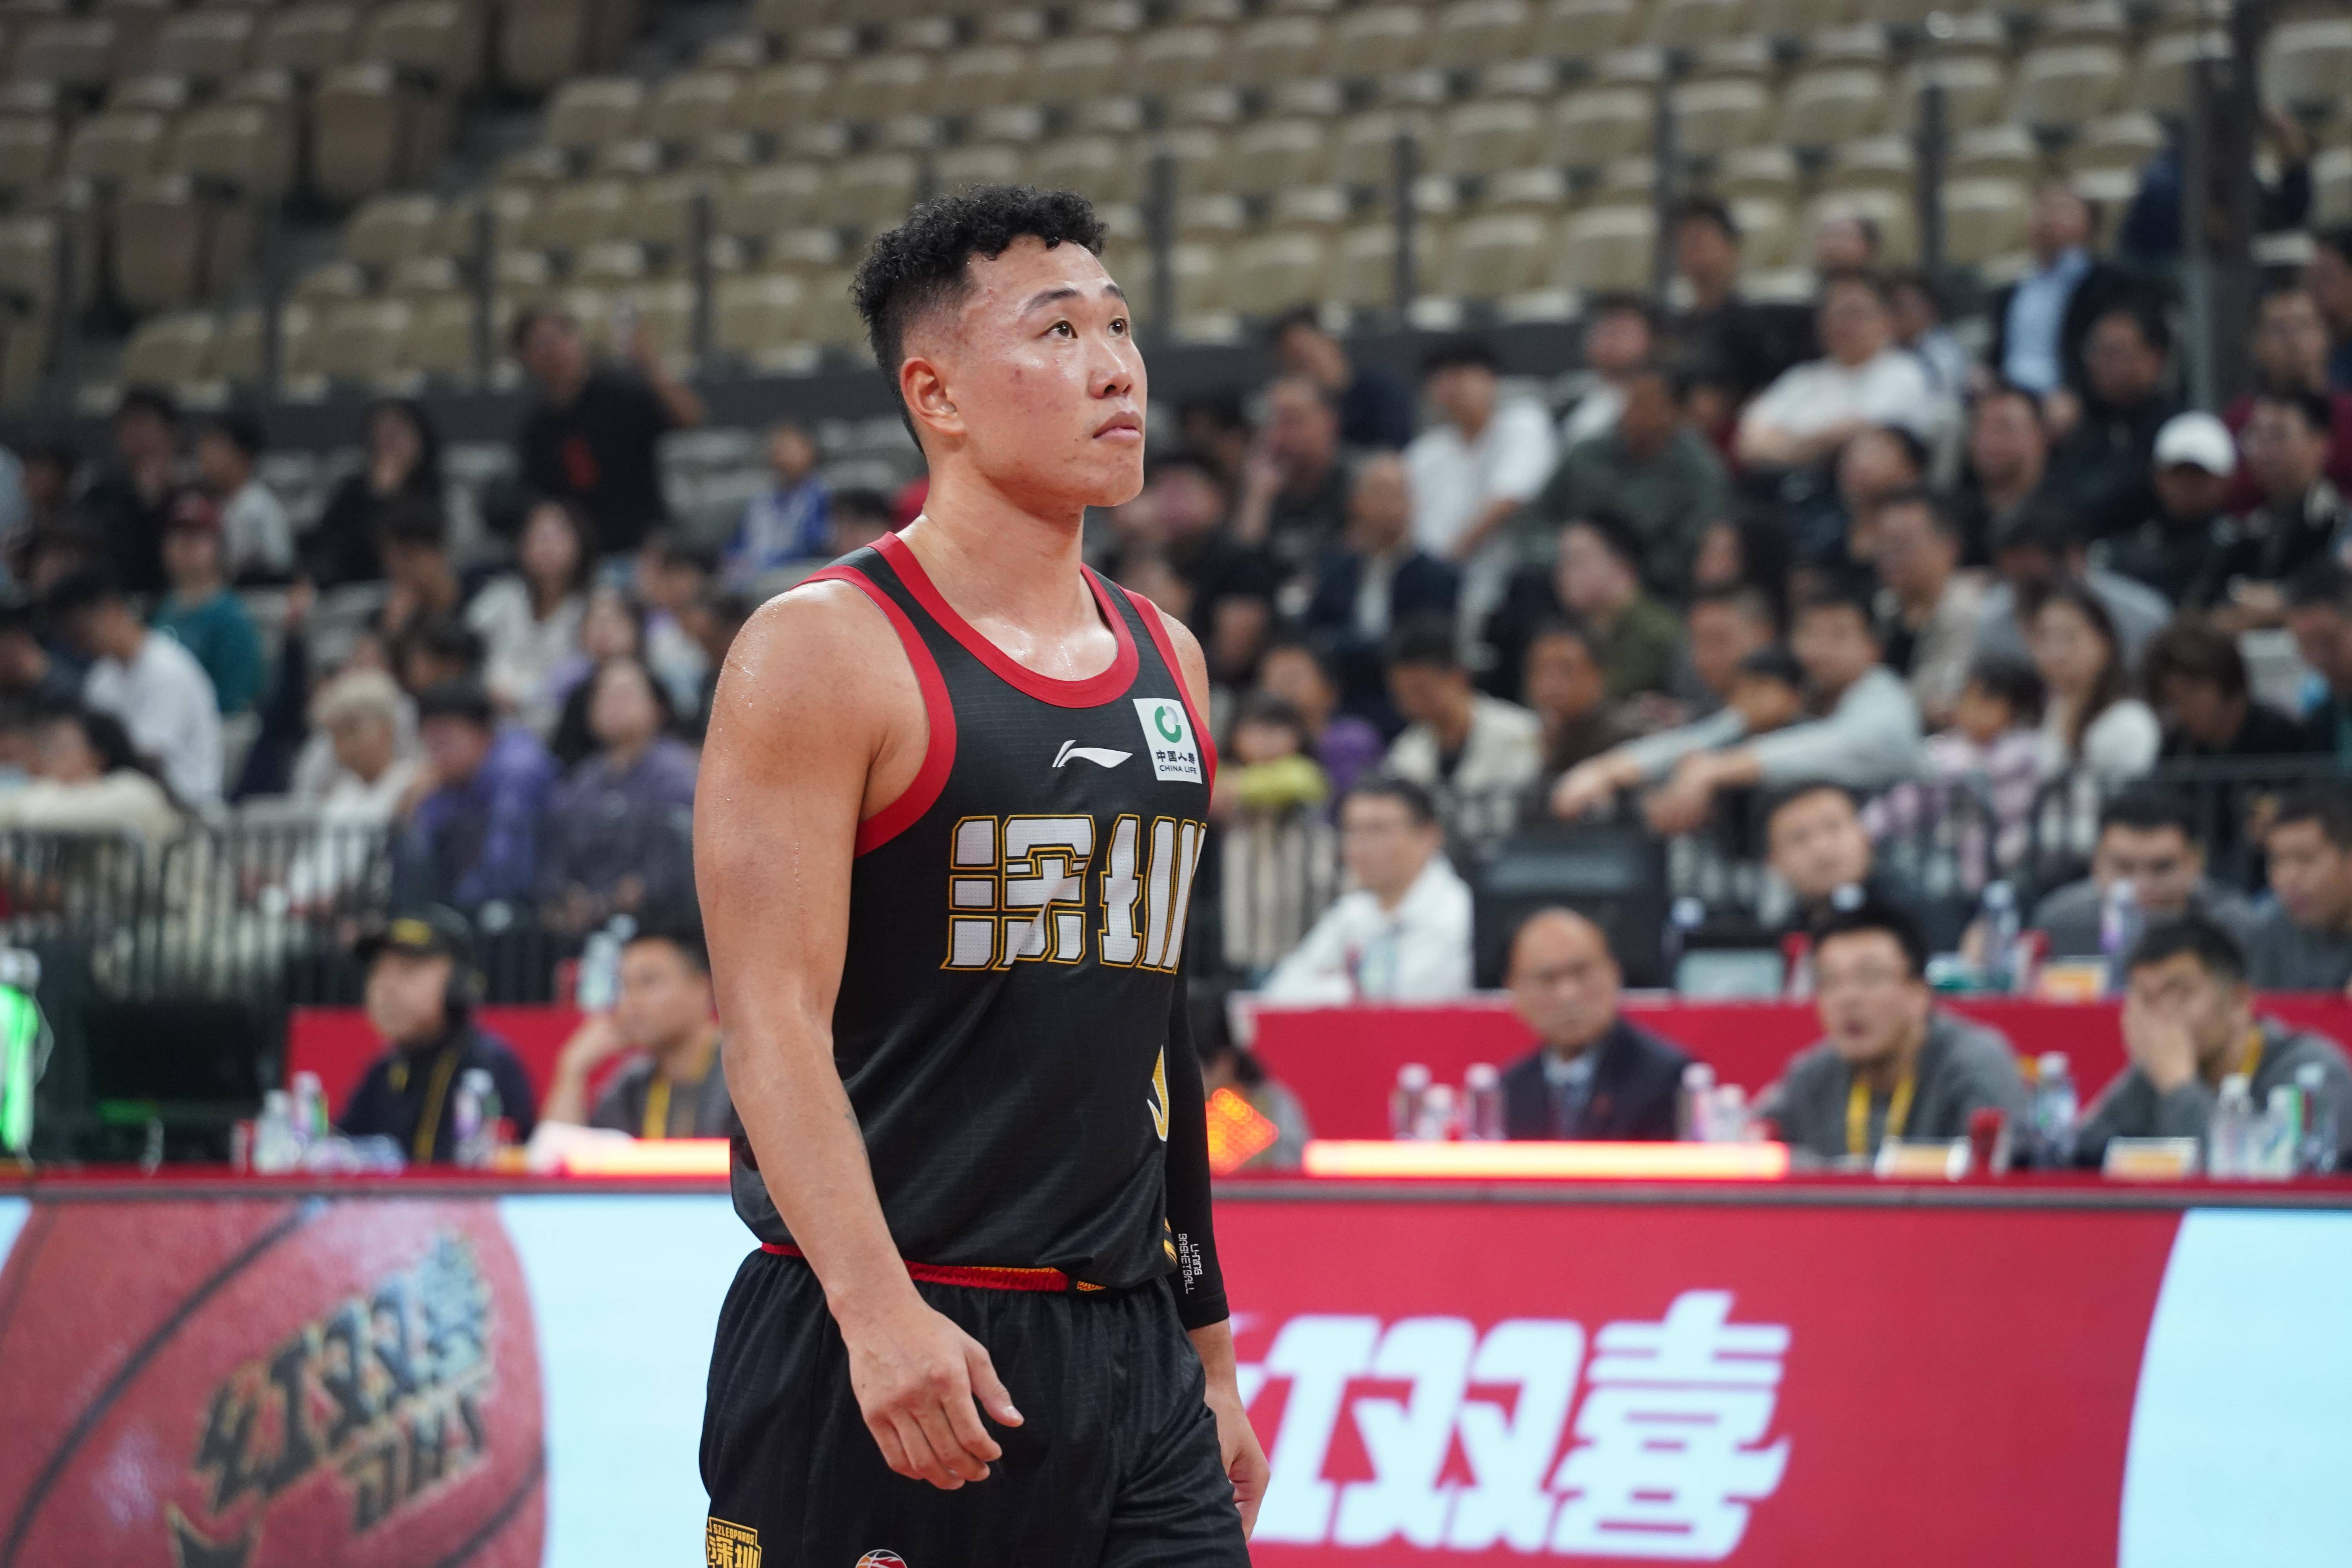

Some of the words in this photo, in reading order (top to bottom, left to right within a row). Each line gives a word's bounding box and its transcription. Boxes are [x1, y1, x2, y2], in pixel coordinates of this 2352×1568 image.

[1184, 766, 1197, 774] LIFE
[713, 1523, 755, 1545] SZLEOPARDS
[708, 1534, 759, 1568] 深圳
